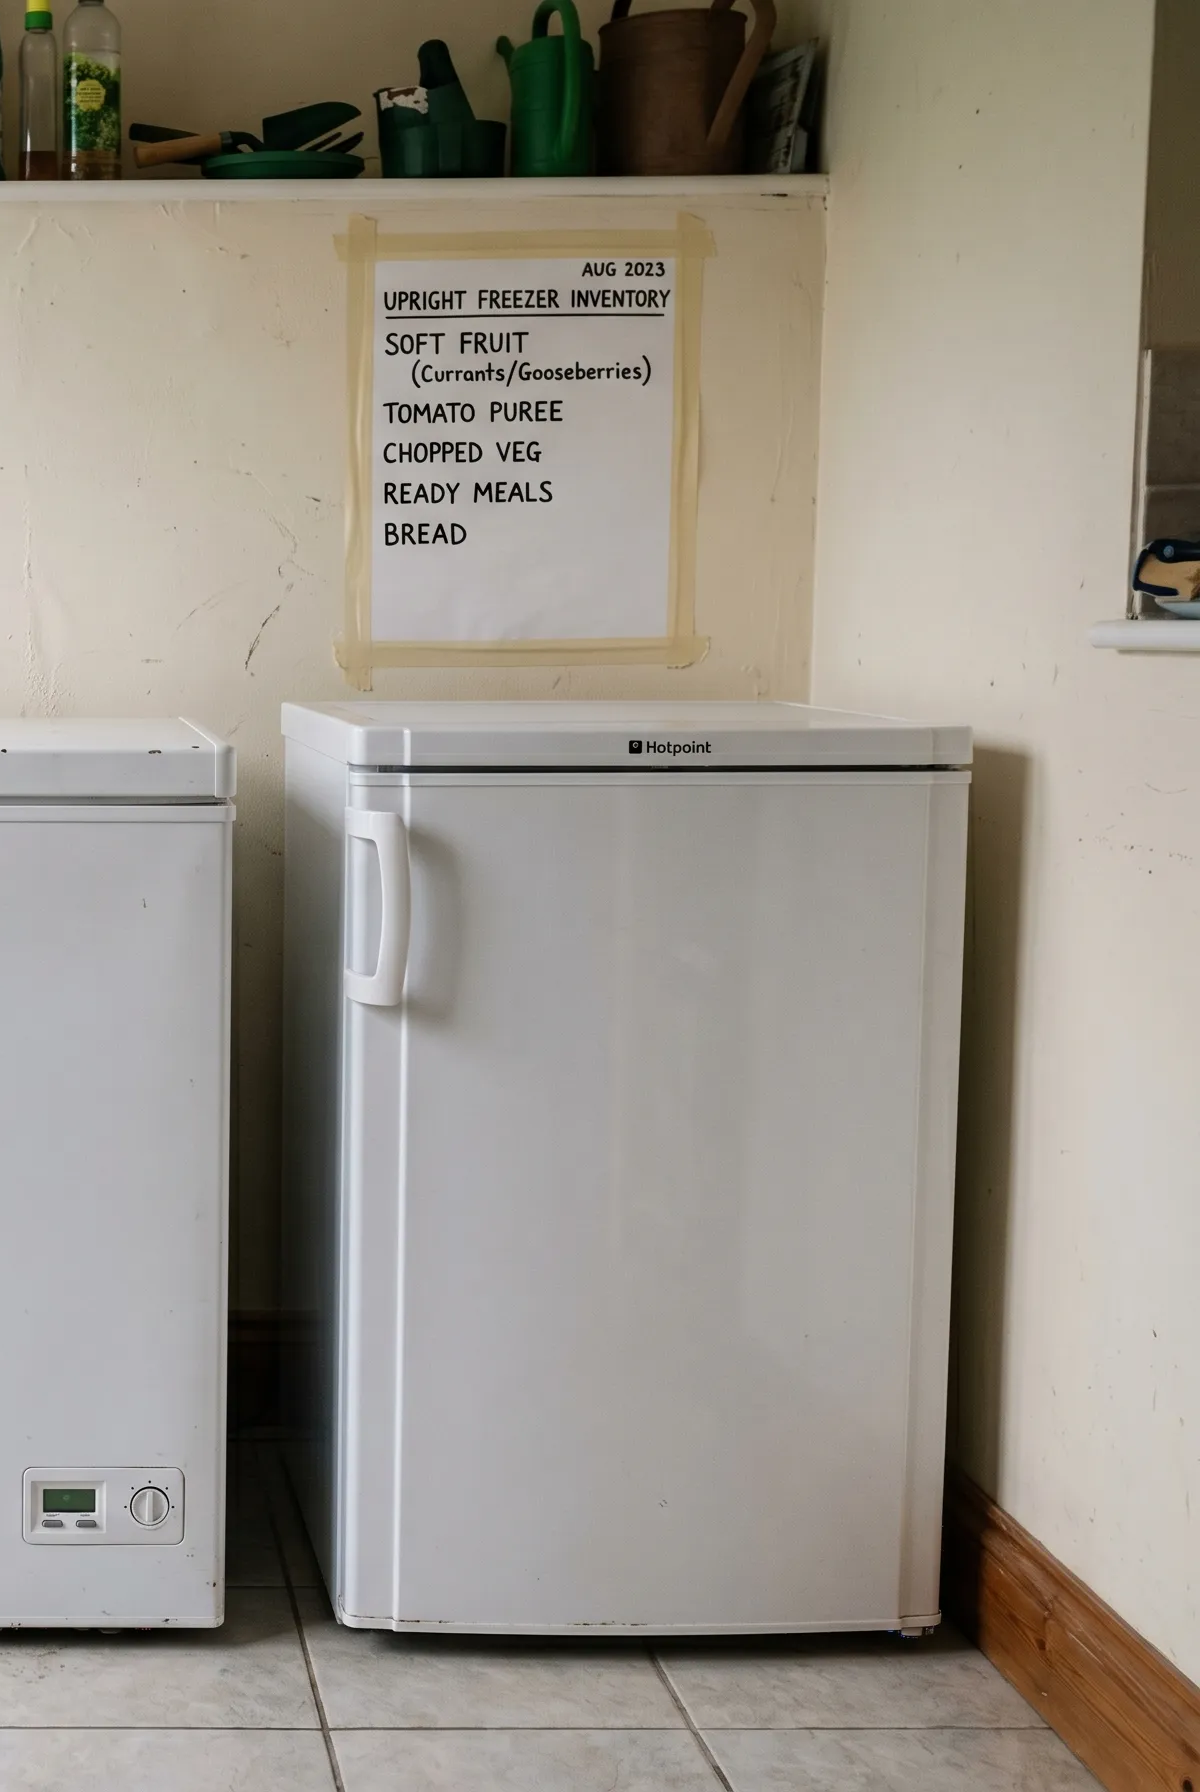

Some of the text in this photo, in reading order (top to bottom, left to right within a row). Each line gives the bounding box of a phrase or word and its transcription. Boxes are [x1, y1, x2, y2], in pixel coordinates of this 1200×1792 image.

[582, 262, 665, 276] AUG 2023
[384, 289, 670, 310] UPRIGHT FREEZER INVENTORY
[385, 332, 529, 355] SOFT FRUIT
[412, 355, 651, 388] (Currants/Gooseberries)
[383, 401, 563, 423] TOMATO PUREE
[384, 441, 541, 463] CHOPPED VEG
[385, 481, 552, 504] READY MEALS
[385, 523, 466, 546] BREAD
[647, 741, 711, 756] Hotpoint
